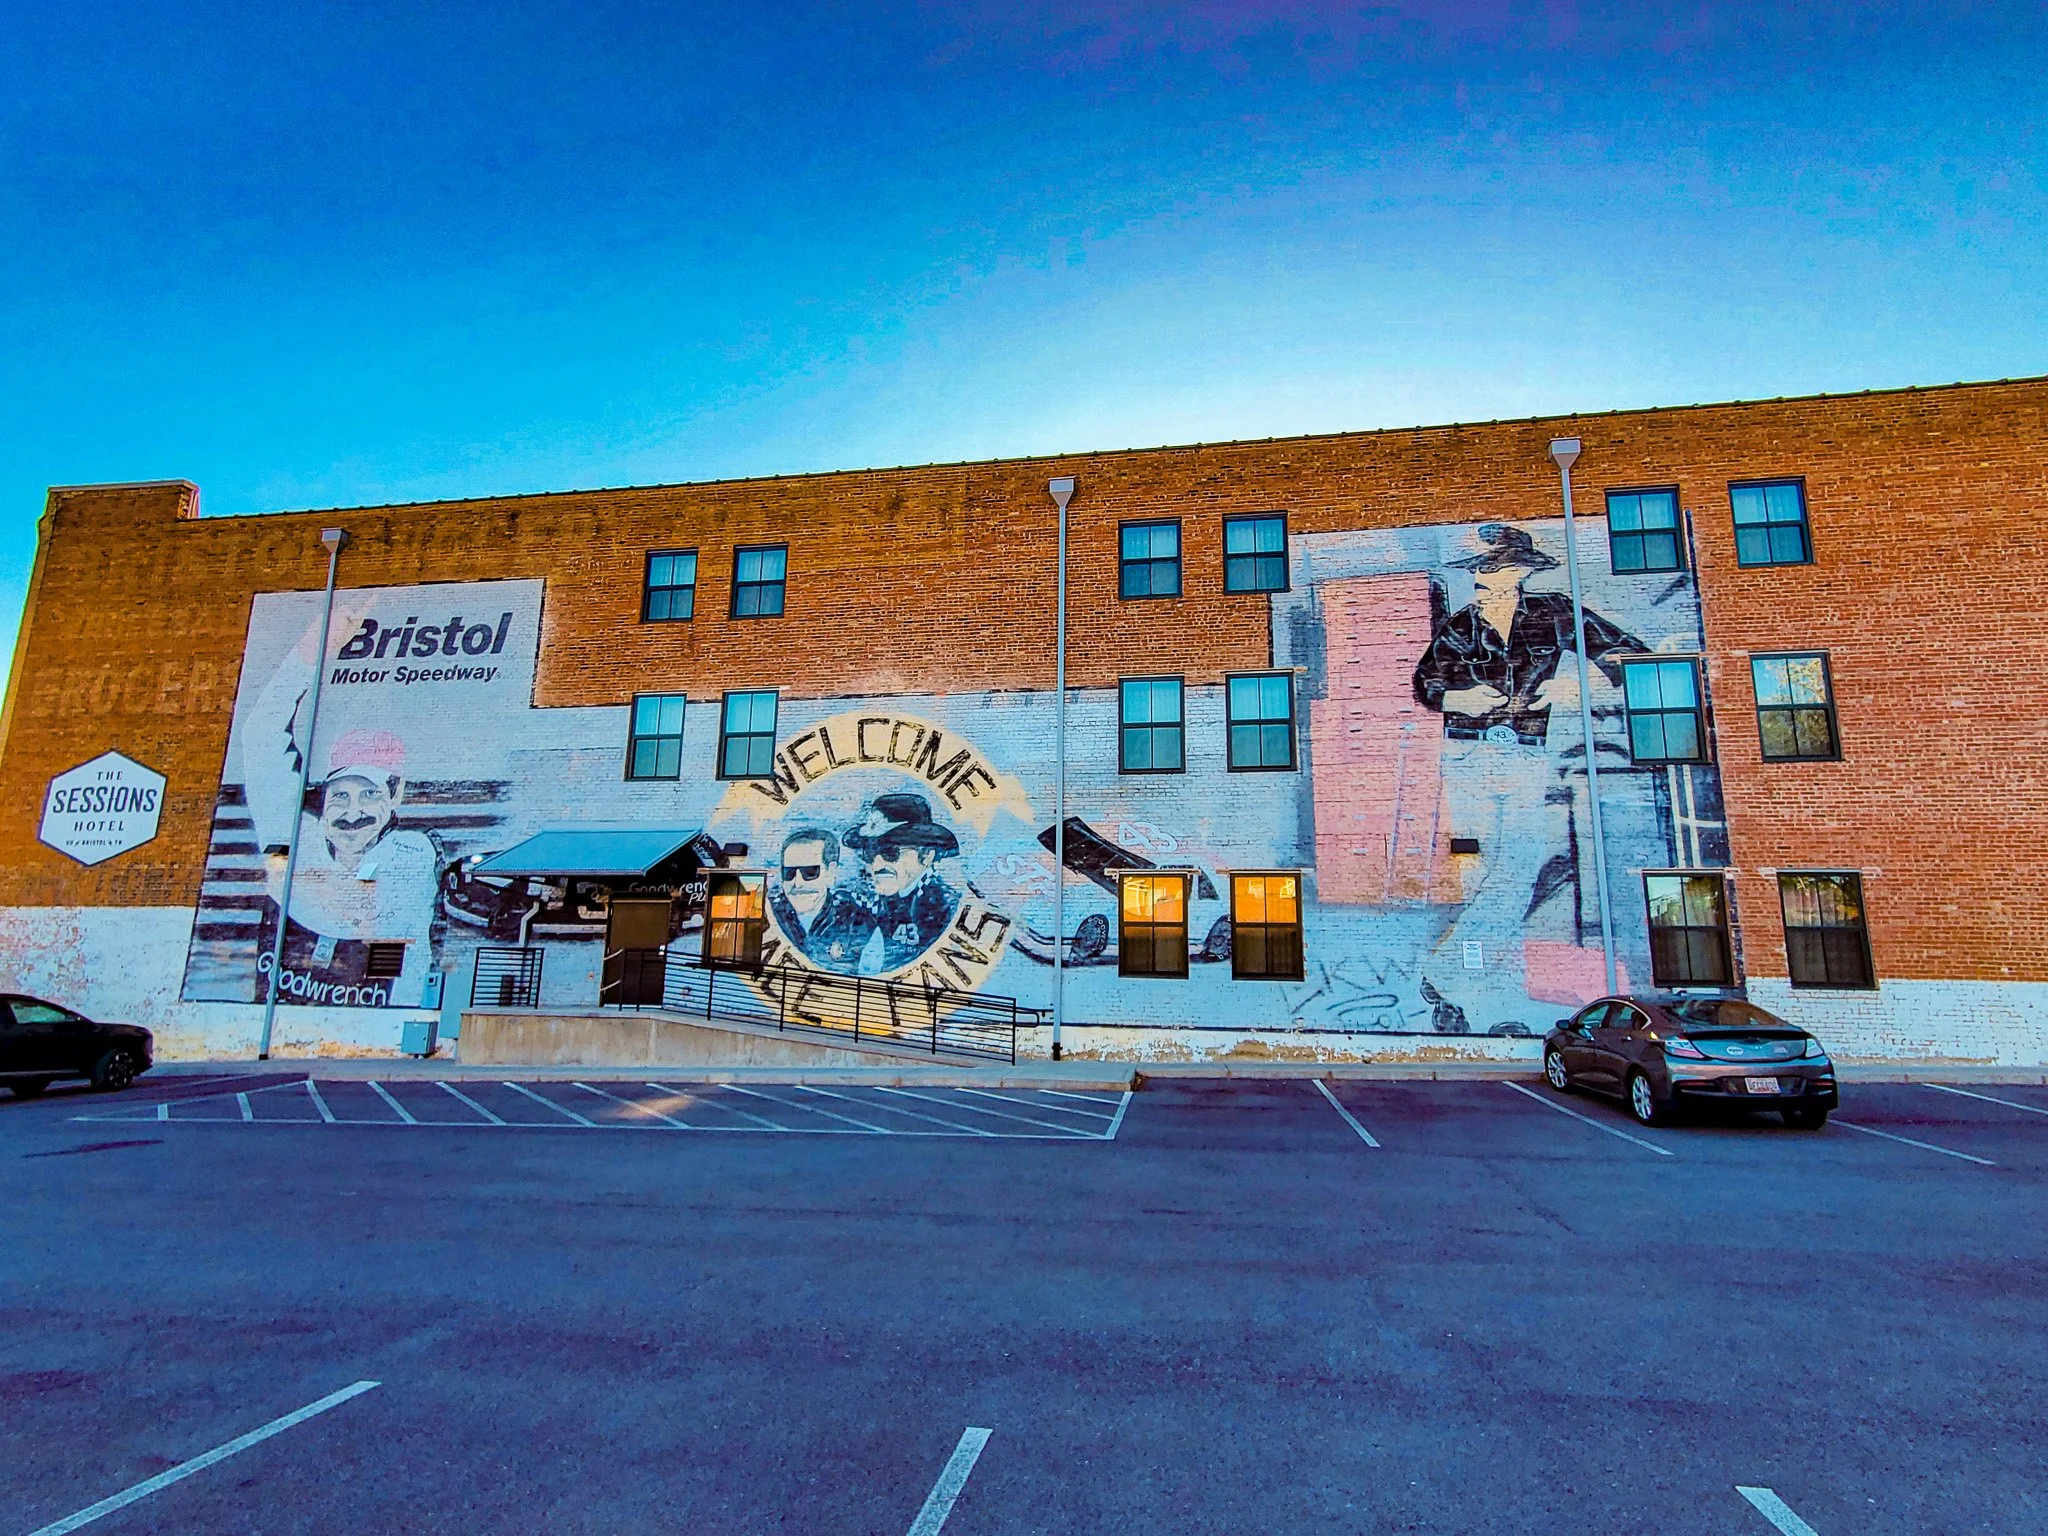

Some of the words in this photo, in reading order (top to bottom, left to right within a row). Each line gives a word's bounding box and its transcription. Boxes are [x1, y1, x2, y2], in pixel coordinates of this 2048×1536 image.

[337, 612, 513, 660] Bristol
[331, 667, 390, 685] Motor
[394, 664, 498, 685] Speedway
[97, 770, 124, 781] THE
[750, 717, 997, 811] WELCOME
[52, 785, 158, 814] SESSIONS
[74, 820, 125, 832] HOTEL
[1118, 821, 1179, 853] 43
[891, 922, 920, 945] 43
[884, 903, 1011, 1027] FANS
